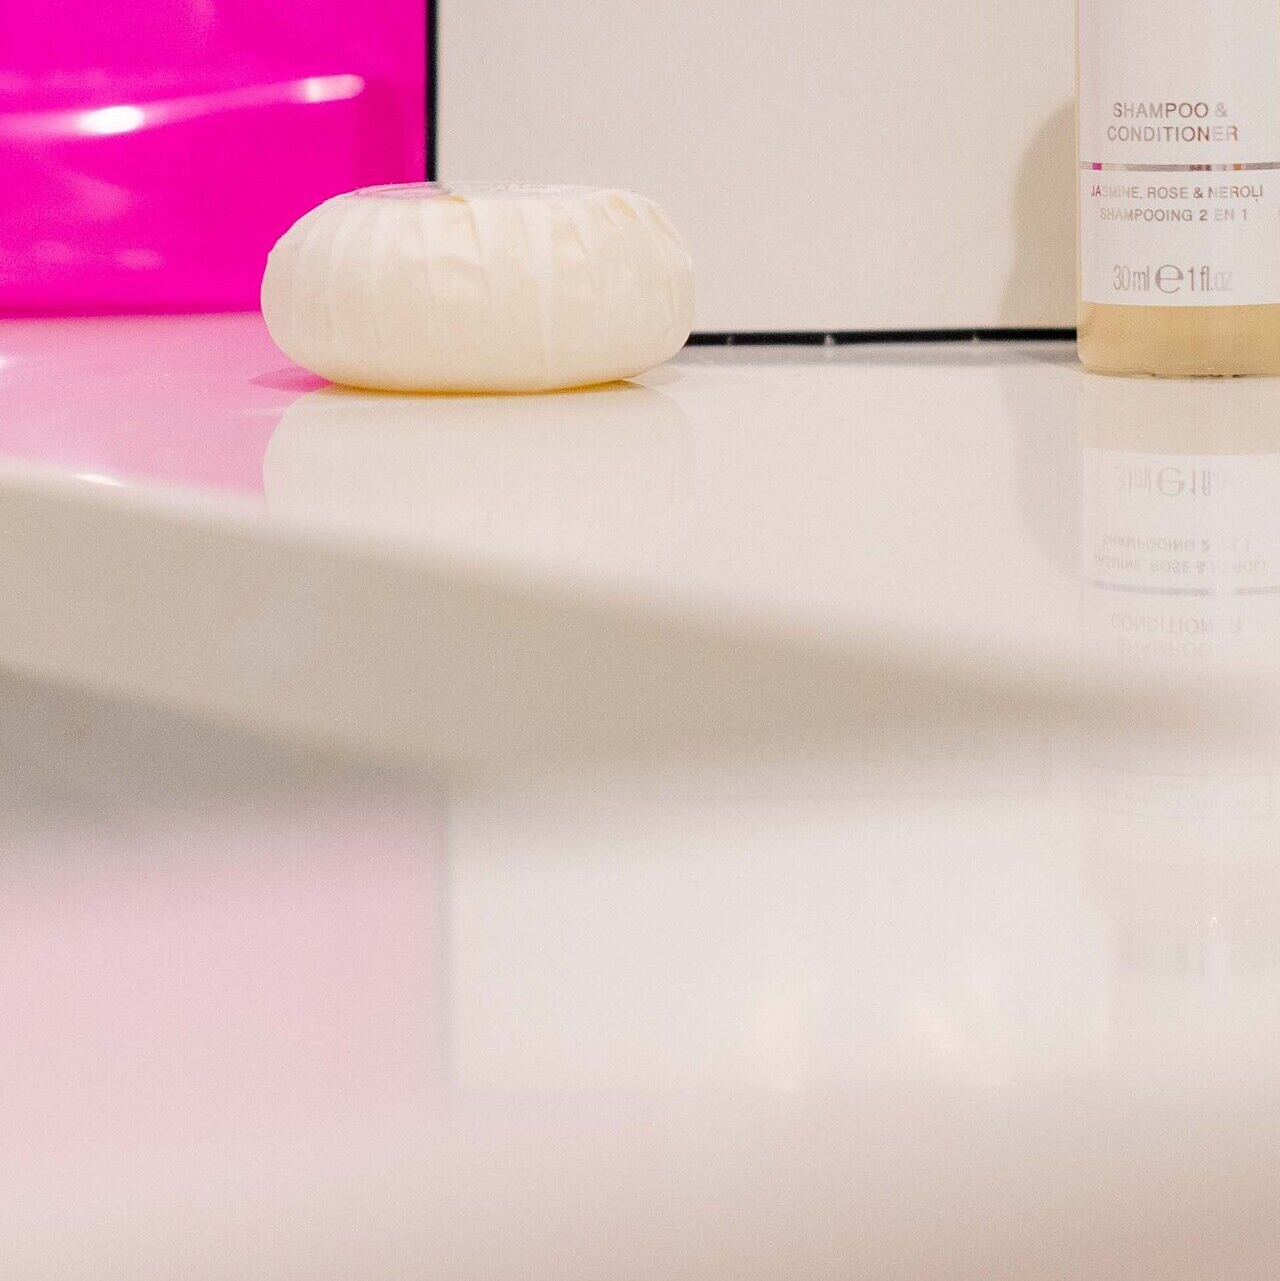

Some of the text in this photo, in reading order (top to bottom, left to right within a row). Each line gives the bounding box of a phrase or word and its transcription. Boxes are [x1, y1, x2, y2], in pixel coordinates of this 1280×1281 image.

[1112, 102, 1229, 119] SHAMPOO &
[1107, 125, 1239, 142] CONDITIONER
[1147, 187, 1189, 199] ROSE
[1193, 187, 1204, 199] &
[1208, 185, 1263, 199] NEROLI
[1100, 209, 1248, 222] SHAMPOOING 2 EN 1
